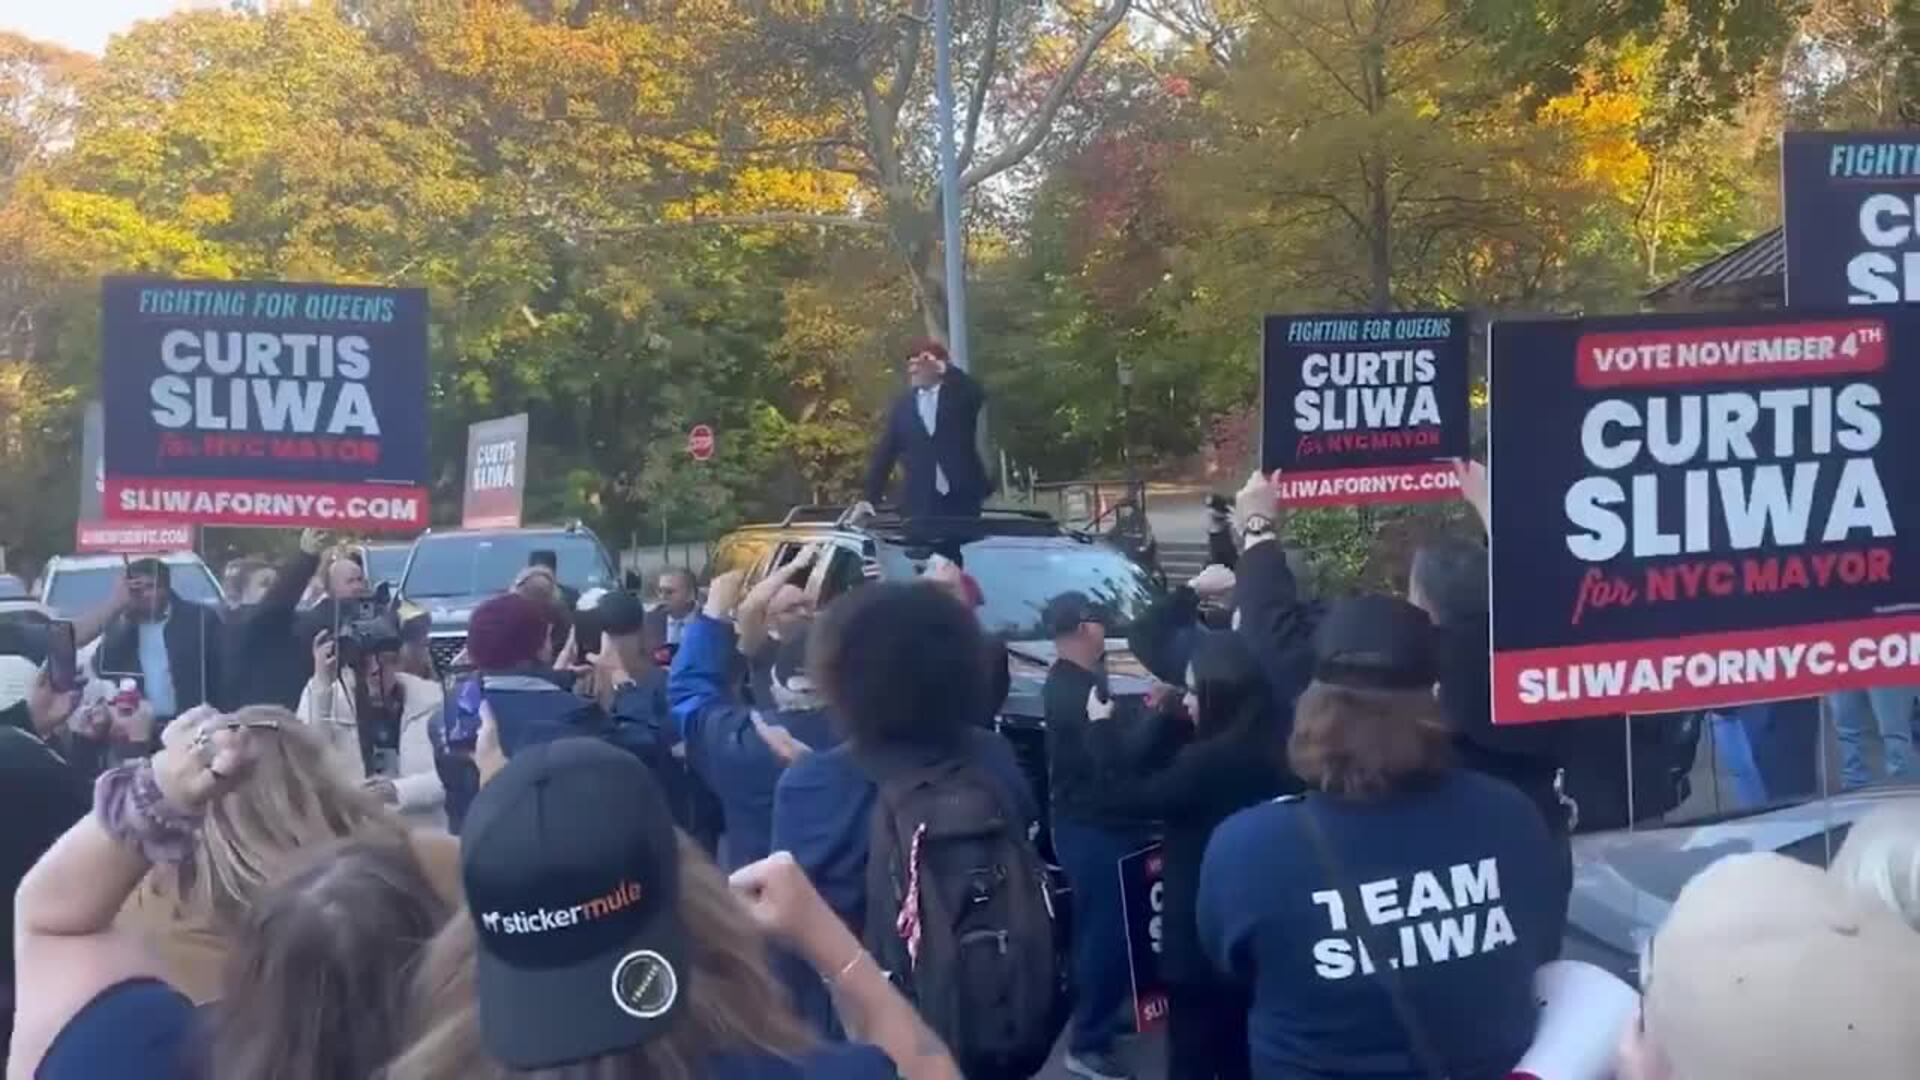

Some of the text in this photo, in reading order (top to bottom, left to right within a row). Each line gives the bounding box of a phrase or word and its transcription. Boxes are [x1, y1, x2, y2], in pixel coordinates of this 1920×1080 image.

[139, 289, 395, 322] FIGHTING FOR QUEENS
[1288, 318, 1451, 342] FIGHTING FOR QUEENS
[160, 329, 371, 380] CURTIS
[1302, 349, 1437, 387] CURTIS
[1593, 344, 1671, 371] VOTE
[1677, 336, 1834, 368] NOVEMBER
[150, 374, 381, 435] SLIWA
[1294, 385, 1441, 432] SLIWA
[1581, 383, 1882, 469] CURTIS
[120, 488, 417, 520] SLIWAFORNYC.COM
[1565, 457, 1896, 561] SLIWA
[1572, 549, 1891, 625] for NYC MAYOR
[502, 878, 641, 934] stickermule
[1312, 857, 1501, 931] TEAM
